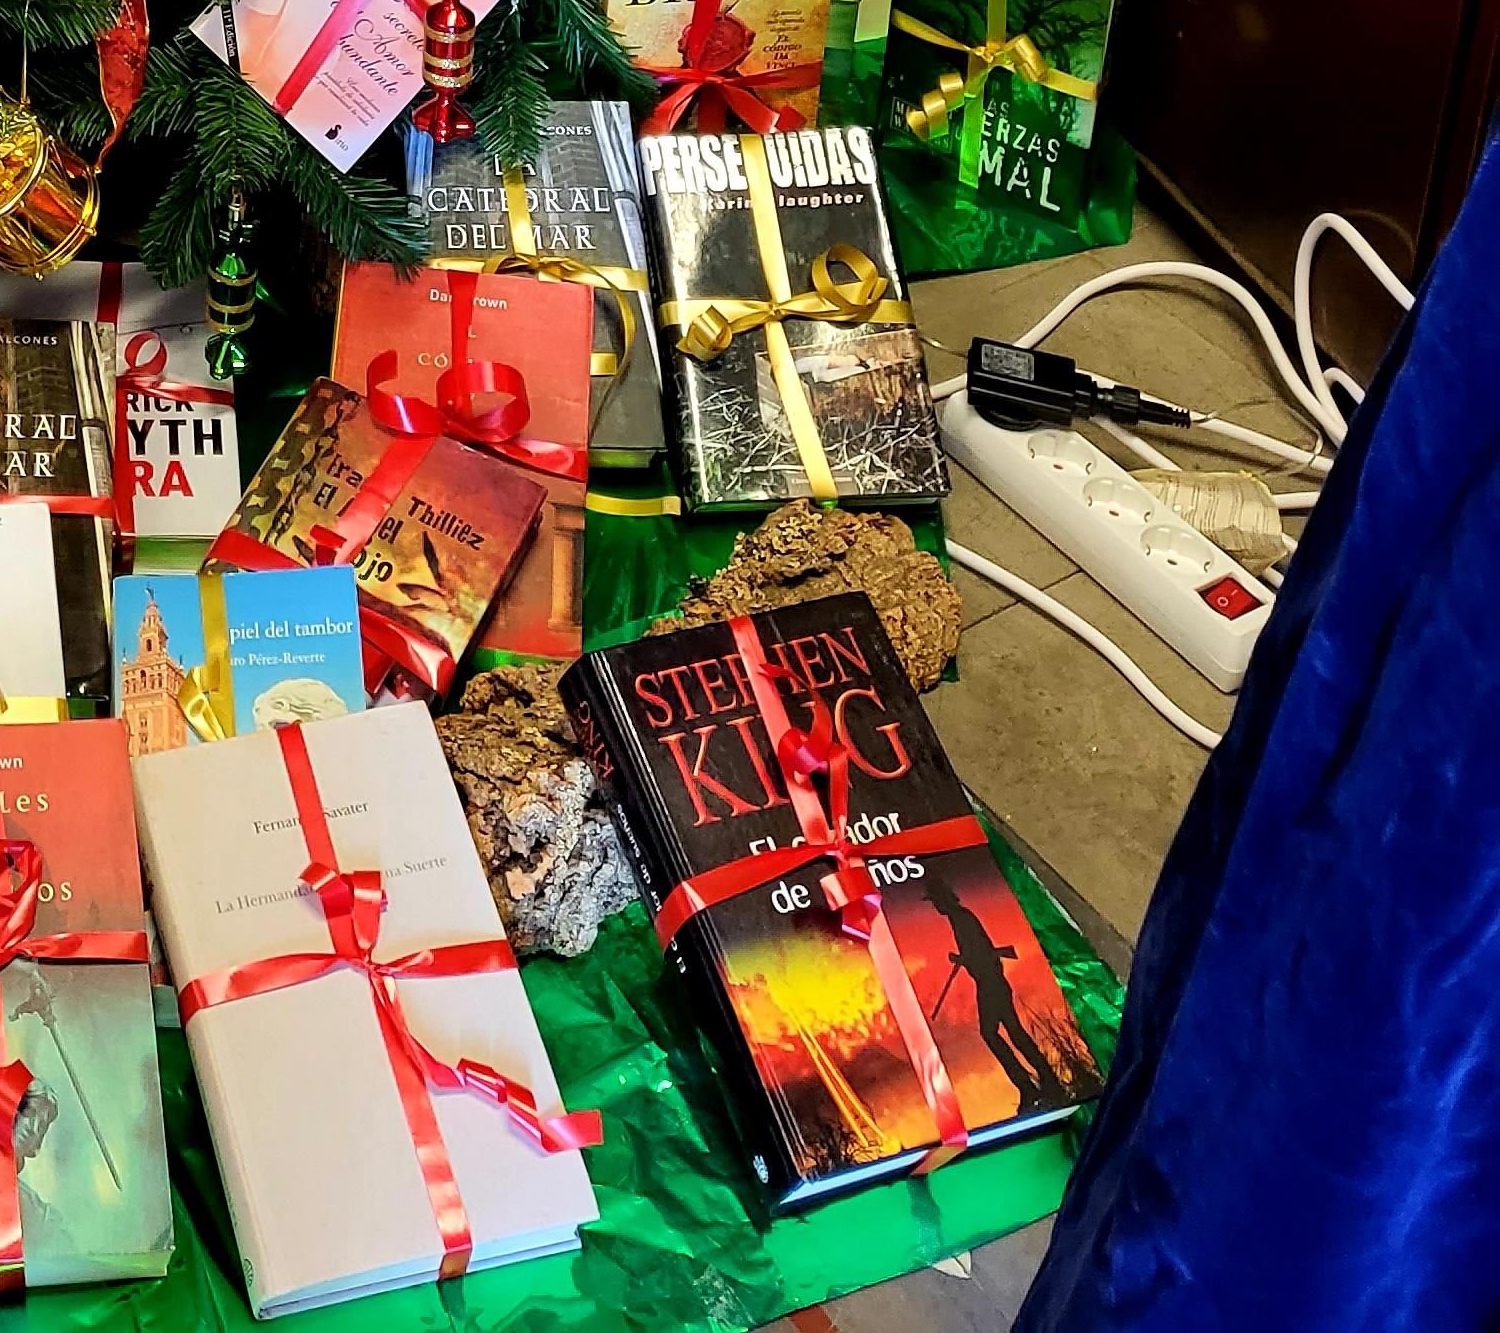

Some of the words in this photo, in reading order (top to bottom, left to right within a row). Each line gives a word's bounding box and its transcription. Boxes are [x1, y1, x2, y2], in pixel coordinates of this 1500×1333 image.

[225, 21, 236, 58] Edición
[643, 129, 874, 195] PERSEUIDAS
[977, 140, 1061, 212] MAL
[446, 224, 506, 250] DEL
[532, 224, 596, 250] MAR
[407, 496, 486, 551] Thilliez
[230, 624, 262, 642] piel
[263, 622, 290, 640] del
[294, 618, 354, 637] tambor
[248, 650, 326, 667] Pérez-Reverte
[214, 898, 234, 915] La
[403, 853, 448, 877] Suerte
[771, 884, 812, 915] de
